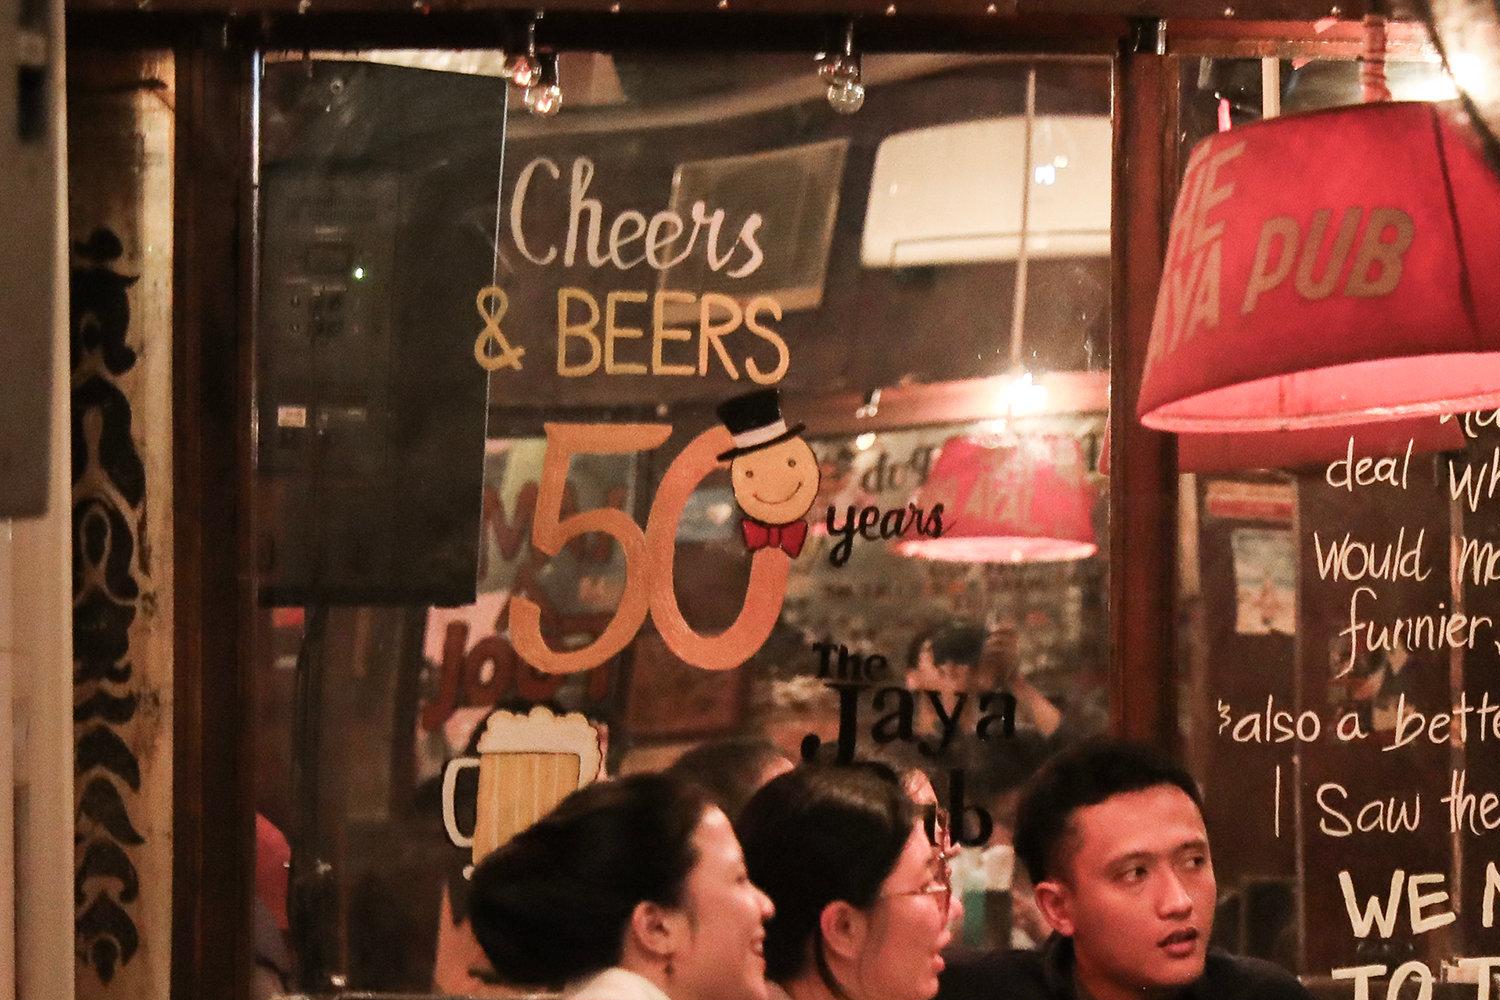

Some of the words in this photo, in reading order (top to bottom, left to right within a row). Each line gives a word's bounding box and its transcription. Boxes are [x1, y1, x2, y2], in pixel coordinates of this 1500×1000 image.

[509, 156, 765, 279] Cheers
[1241, 206, 1416, 316] PUB
[474, 286, 525, 371] &
[557, 287, 790, 385] BEERS
[1326, 436, 1414, 493] deal
[508, 421, 790, 673] 50
[826, 501, 956, 567] years
[1313, 527, 1432, 584] would
[811, 641, 888, 682] The
[800, 681, 1018, 764] Jaya
[1336, 712, 1369, 742] a
[1338, 868, 1457, 938] WE
